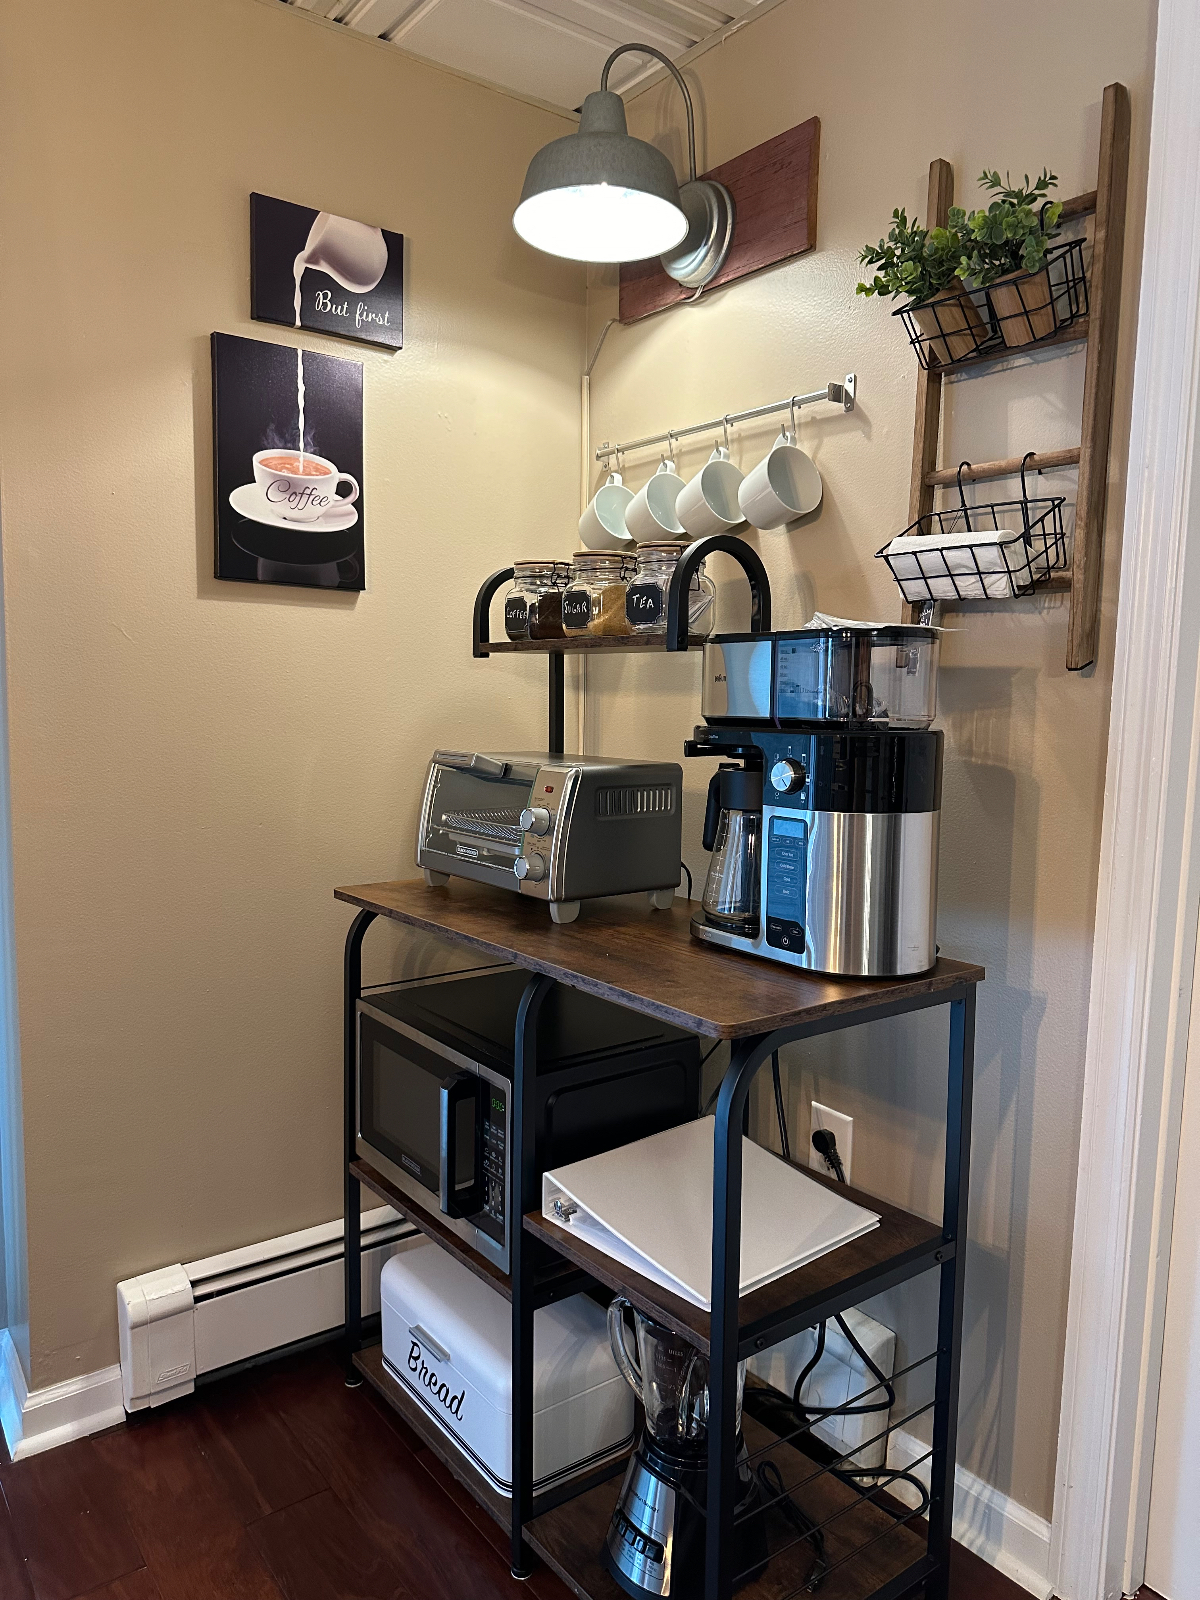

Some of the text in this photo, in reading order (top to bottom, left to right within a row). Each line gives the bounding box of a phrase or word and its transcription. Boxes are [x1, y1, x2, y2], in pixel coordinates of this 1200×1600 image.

[315, 289, 391, 329] But first
[265, 478, 331, 511] Coffee
[564, 600, 587, 614] SUGAR
[632, 593, 654, 610] TEA
[407, 1339, 466, 1422] Bread
